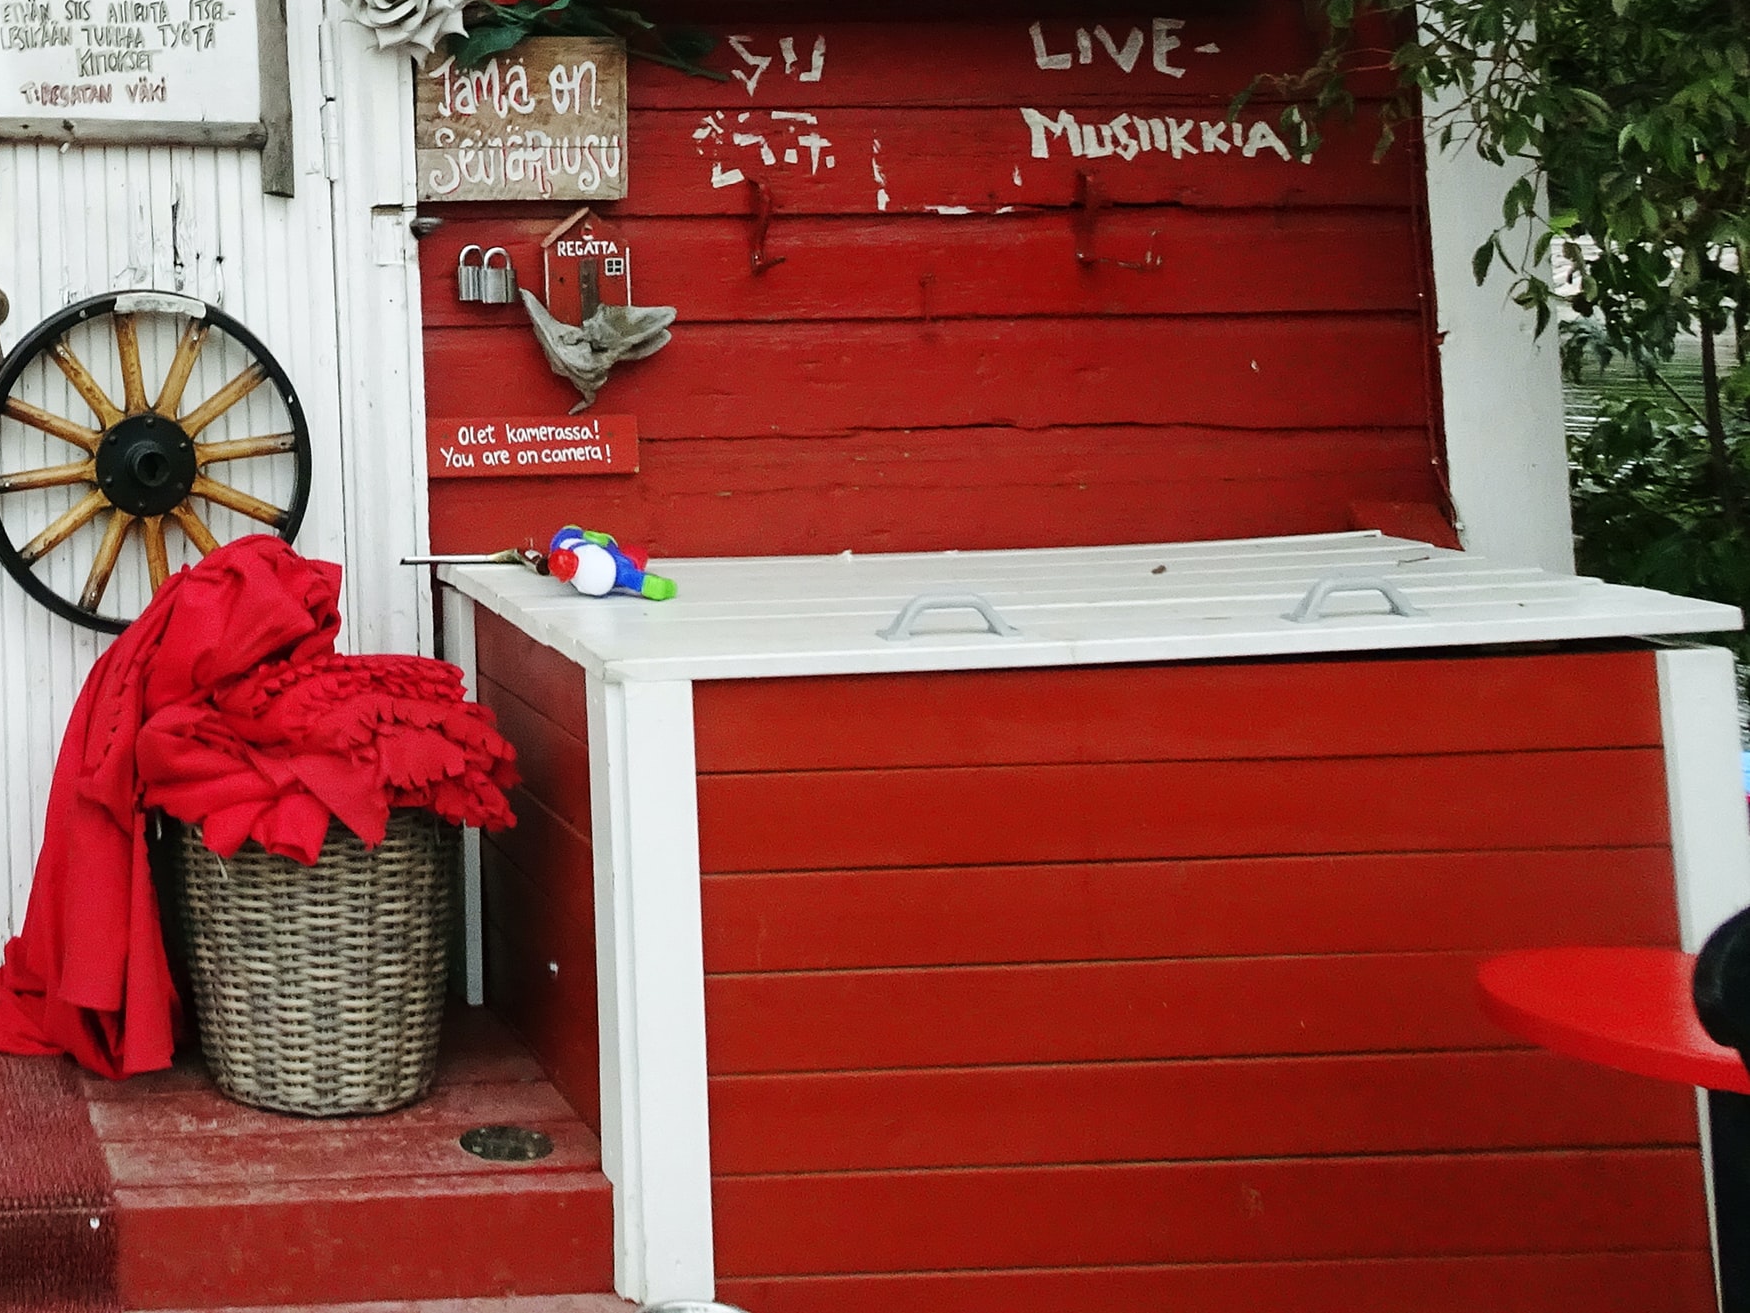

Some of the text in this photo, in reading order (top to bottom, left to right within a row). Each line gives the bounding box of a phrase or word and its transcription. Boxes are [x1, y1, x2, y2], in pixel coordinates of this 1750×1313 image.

[65, 0, 91, 21] SIIS
[157, 21, 216, 52] TYÖTÄ
[1029, 17, 1221, 78] LIVE-
[125, 77, 167, 103] VÄKI
[549, 60, 602, 115] on
[557, 241, 618, 257] REGATTA
[458, 420, 600, 445] Olet kamerassa!
[440, 447, 475, 468] You
[483, 449, 510, 465] are
[517, 449, 539, 464] on
